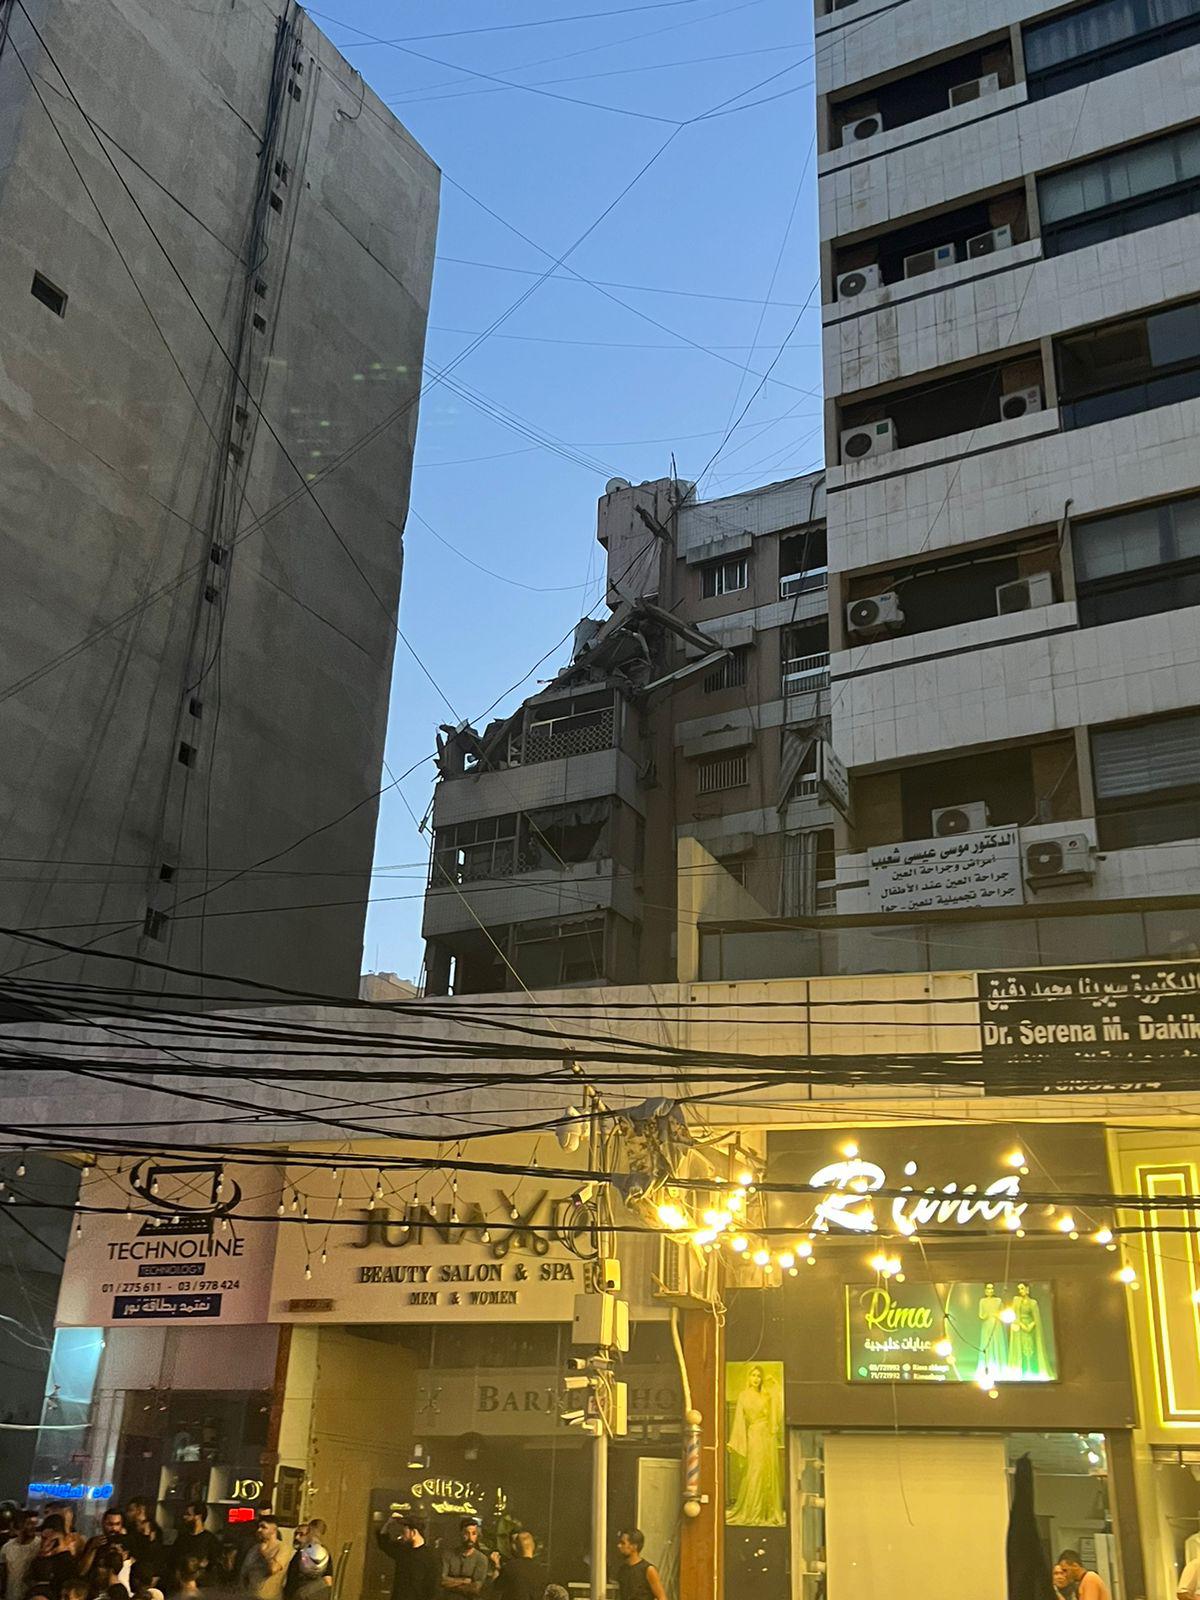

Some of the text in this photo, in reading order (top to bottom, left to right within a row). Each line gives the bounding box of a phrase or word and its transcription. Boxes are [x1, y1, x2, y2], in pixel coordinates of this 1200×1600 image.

[871, 832, 1016, 870] الدكتور موسى عيسى شعيب
[892, 868, 917, 880] العين
[920, 862, 960, 875] وجراحة
[974, 871, 1009, 882] جراحة
[921, 880, 942, 891] عند
[945, 876, 972, 889] العين
[937, 890, 977, 906] تجميلية
[980, 887, 1016, 897] جراحة
[983, 1021, 1013, 1046] Dr.
[1020, 1019, 1097, 1045] Serena
[1102, 1015, 1130, 1042] M.
[808, 1160, 1028, 1238] Rima
[107, 1238, 245, 1261] TECHNOLINE
[140, 1264, 204, 1275] TECHNOLOGY
[359, 1262, 575, 1284] BEAUTY SALON & SPA
[409, 1290, 519, 1306] MEN & WOMEN
[860, 1287, 933, 1333] Rima
